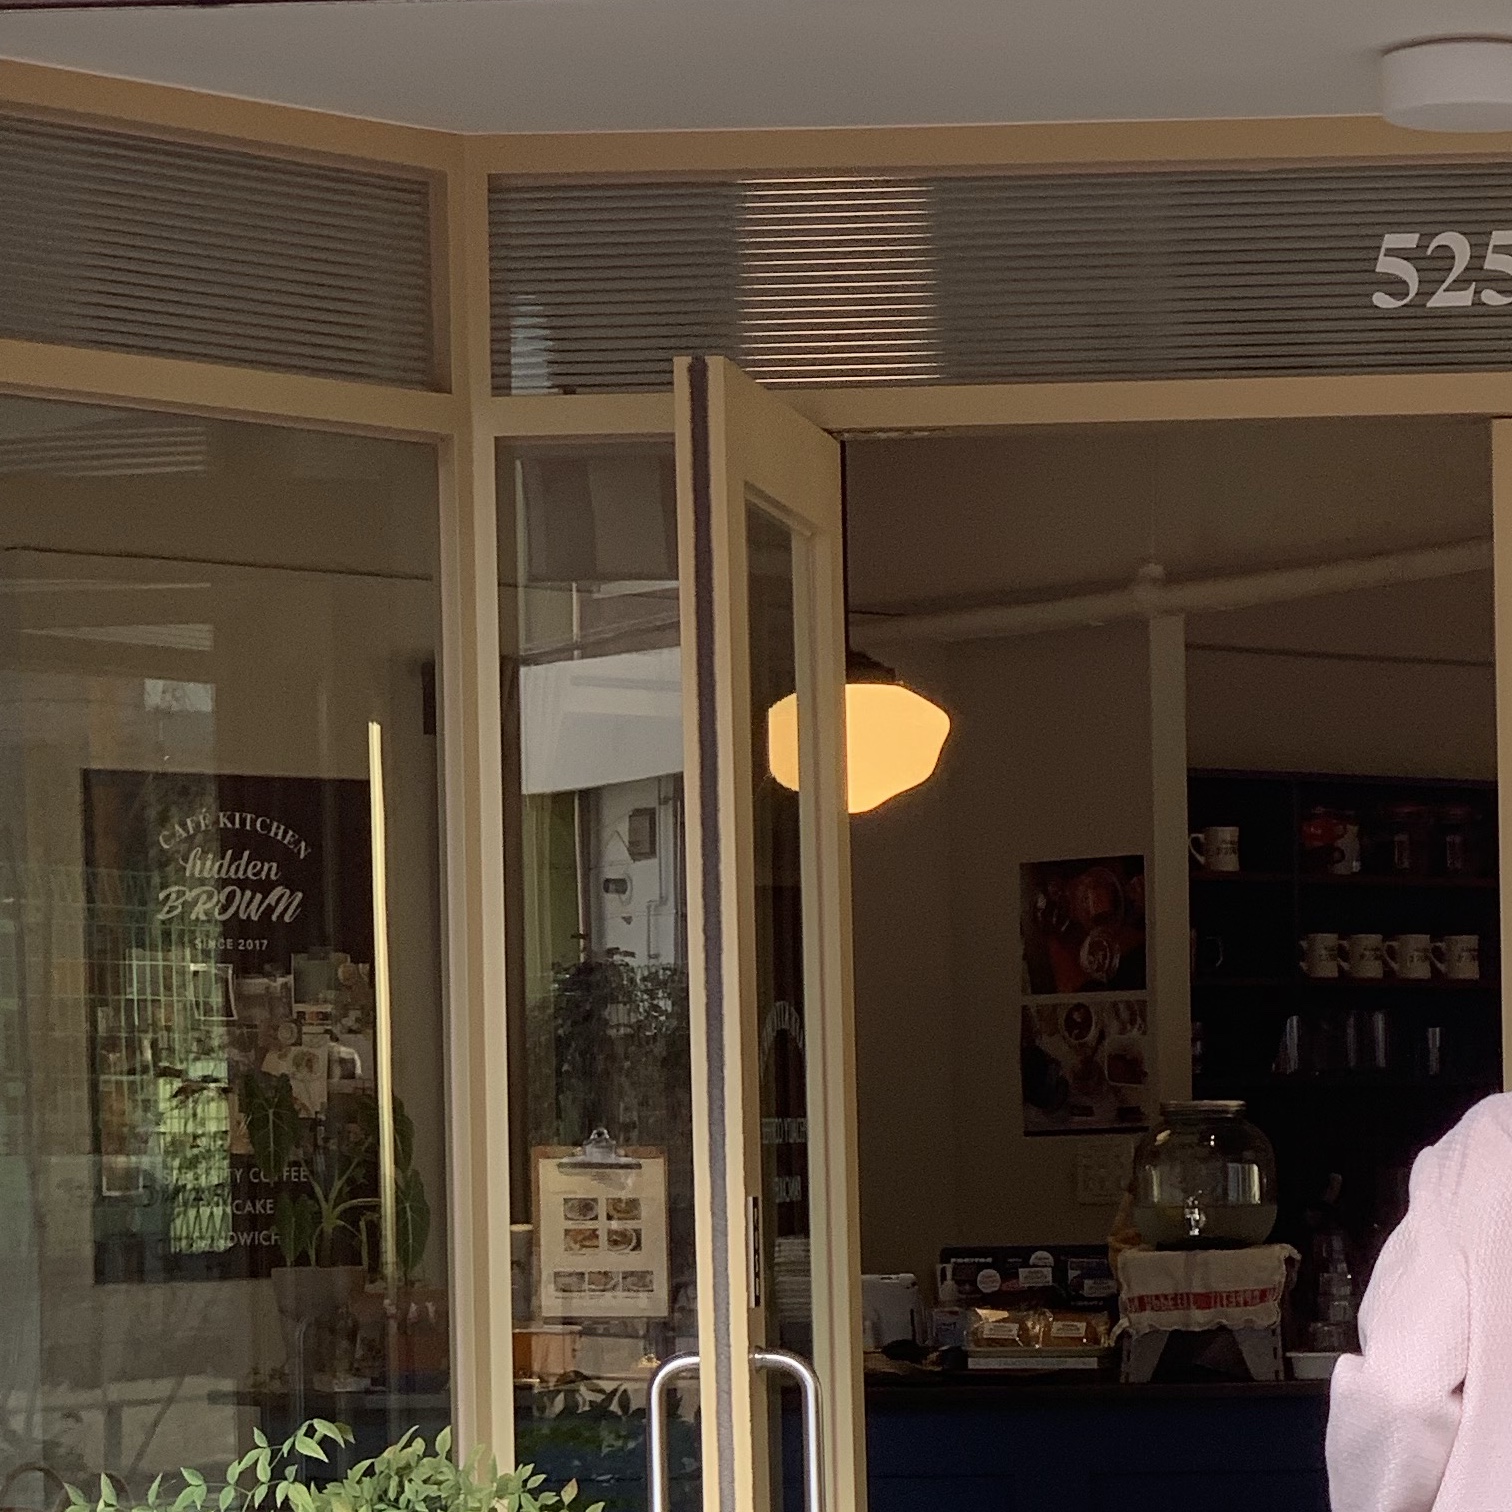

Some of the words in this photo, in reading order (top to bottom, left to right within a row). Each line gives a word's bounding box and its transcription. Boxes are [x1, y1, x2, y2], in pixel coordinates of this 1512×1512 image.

[158, 808, 212, 850] CAFÉ
[218, 811, 312, 860] KITCHEN
[179, 847, 281, 881] hidden
[156, 885, 303, 923] BROWN
[194, 938, 234, 950] SINCE
[238, 938, 268, 950] 2017
[164, 1168, 244, 1184] SPECTY
[250, 1167, 308, 1182] CFEE
